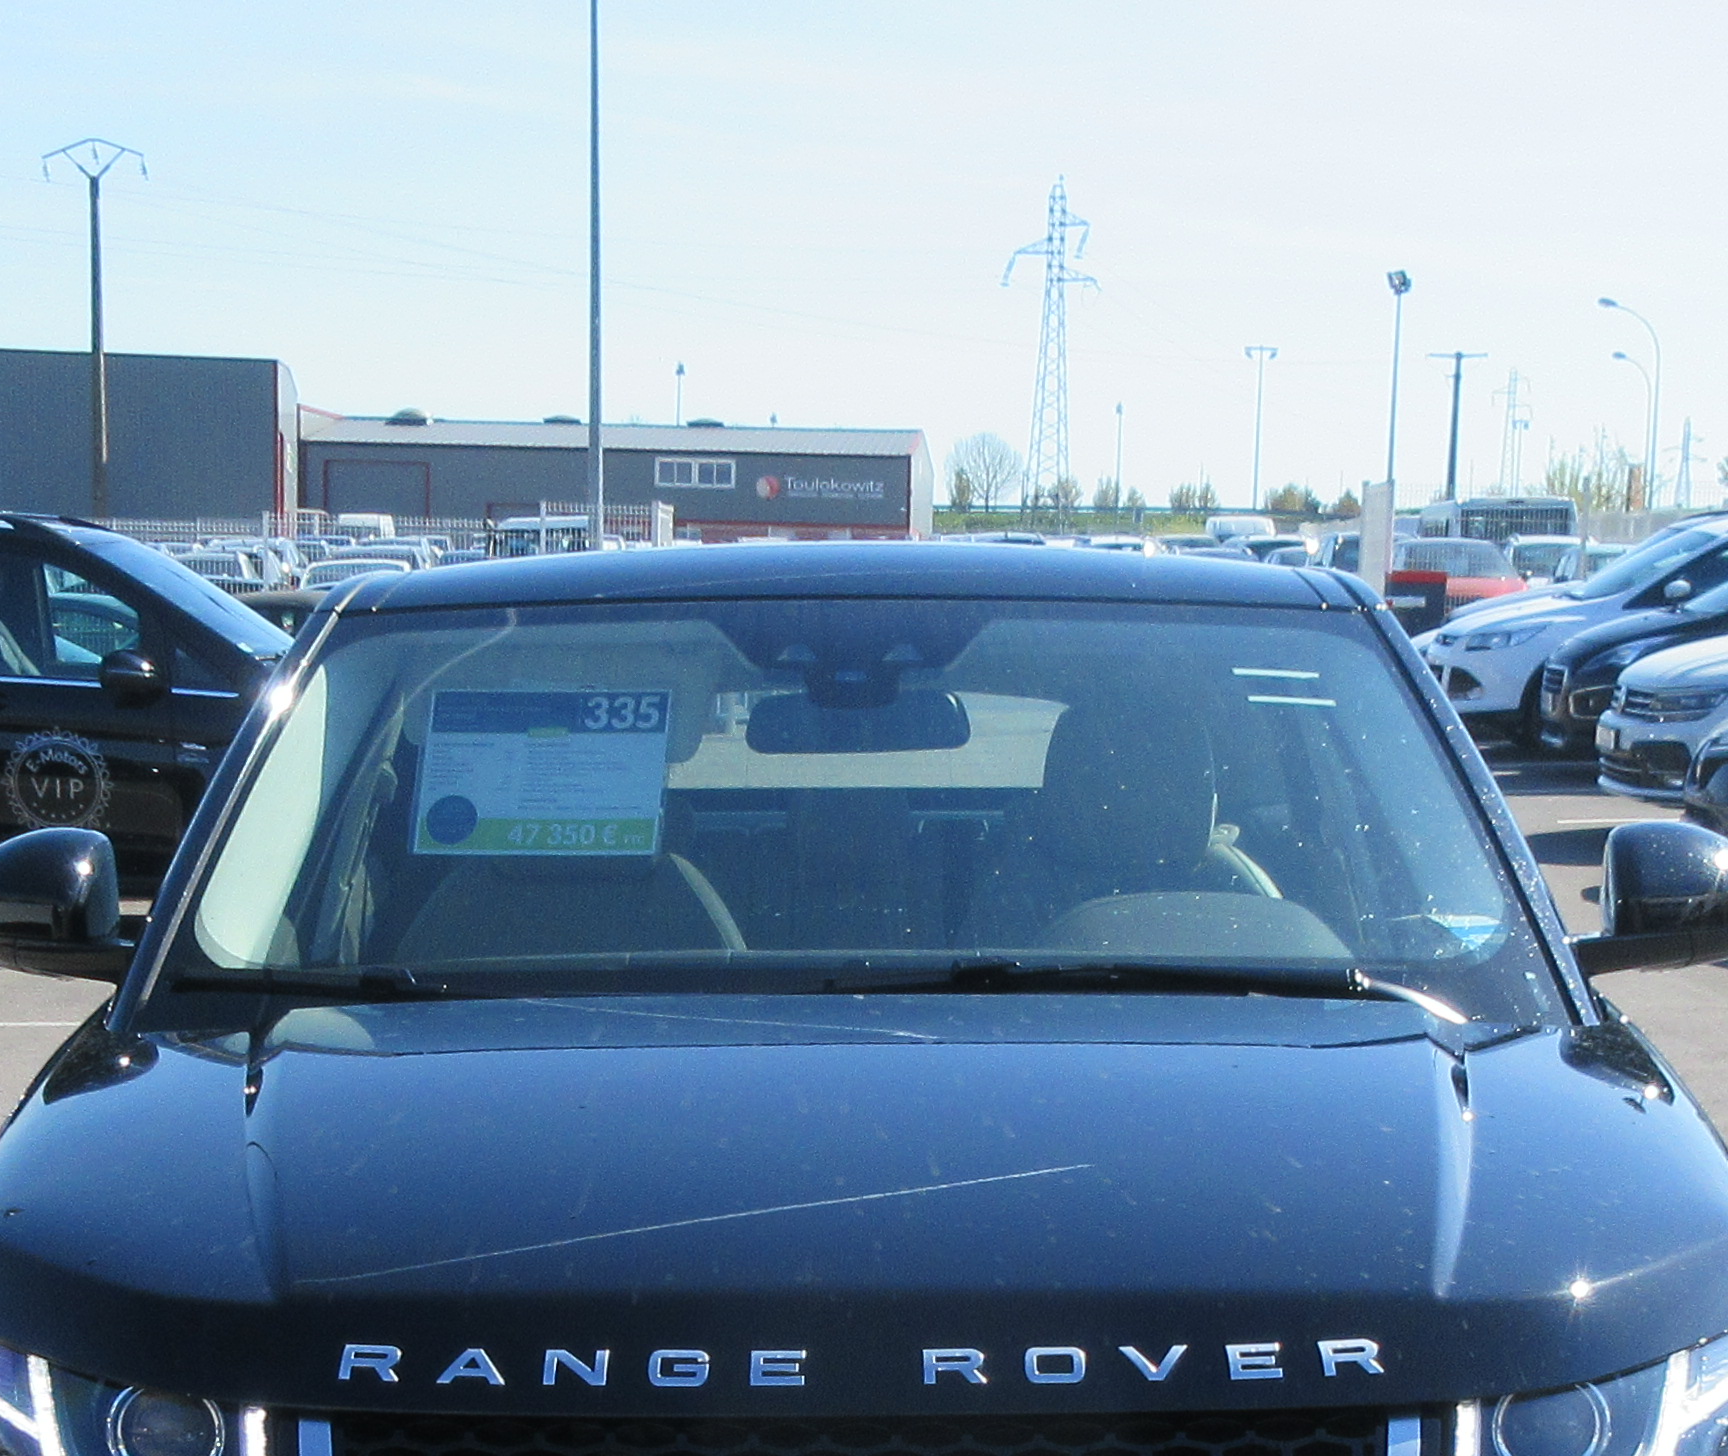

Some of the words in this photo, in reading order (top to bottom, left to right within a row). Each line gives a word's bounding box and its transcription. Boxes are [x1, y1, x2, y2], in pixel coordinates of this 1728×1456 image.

[584, 696, 661, 730] 335
[25, 748, 88, 775] E-Motors
[30, 777, 85, 799] VIP
[507, 822, 542, 846] 47
[546, 822, 597, 846] 350
[602, 823, 618, 846] €
[337, 1343, 808, 1387] RANGE
[922, 1337, 1386, 1385] ROVER
